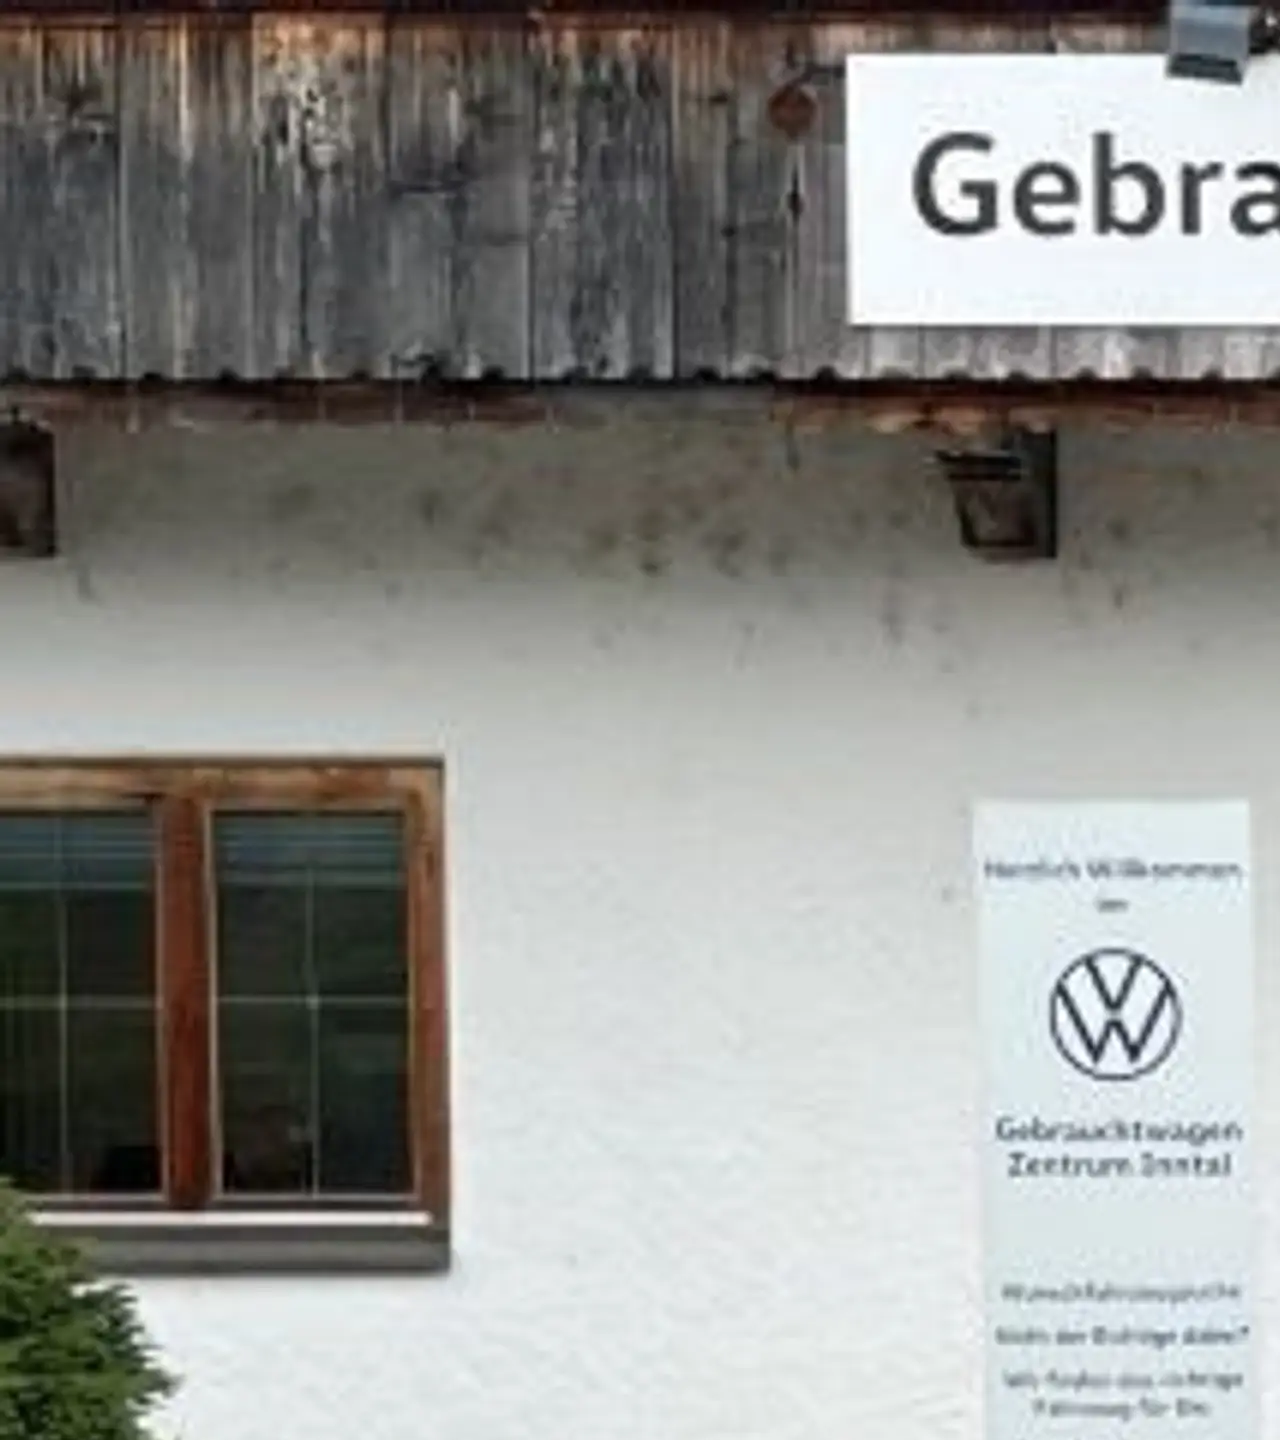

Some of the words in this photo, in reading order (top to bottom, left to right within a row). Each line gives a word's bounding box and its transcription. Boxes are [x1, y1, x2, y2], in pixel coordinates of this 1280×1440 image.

[994, 1115, 1245, 1147] Gebrauchtwagen
[1006, 1151, 1134, 1178] Zentrum
[1139, 1151, 1233, 1178] Inntal
